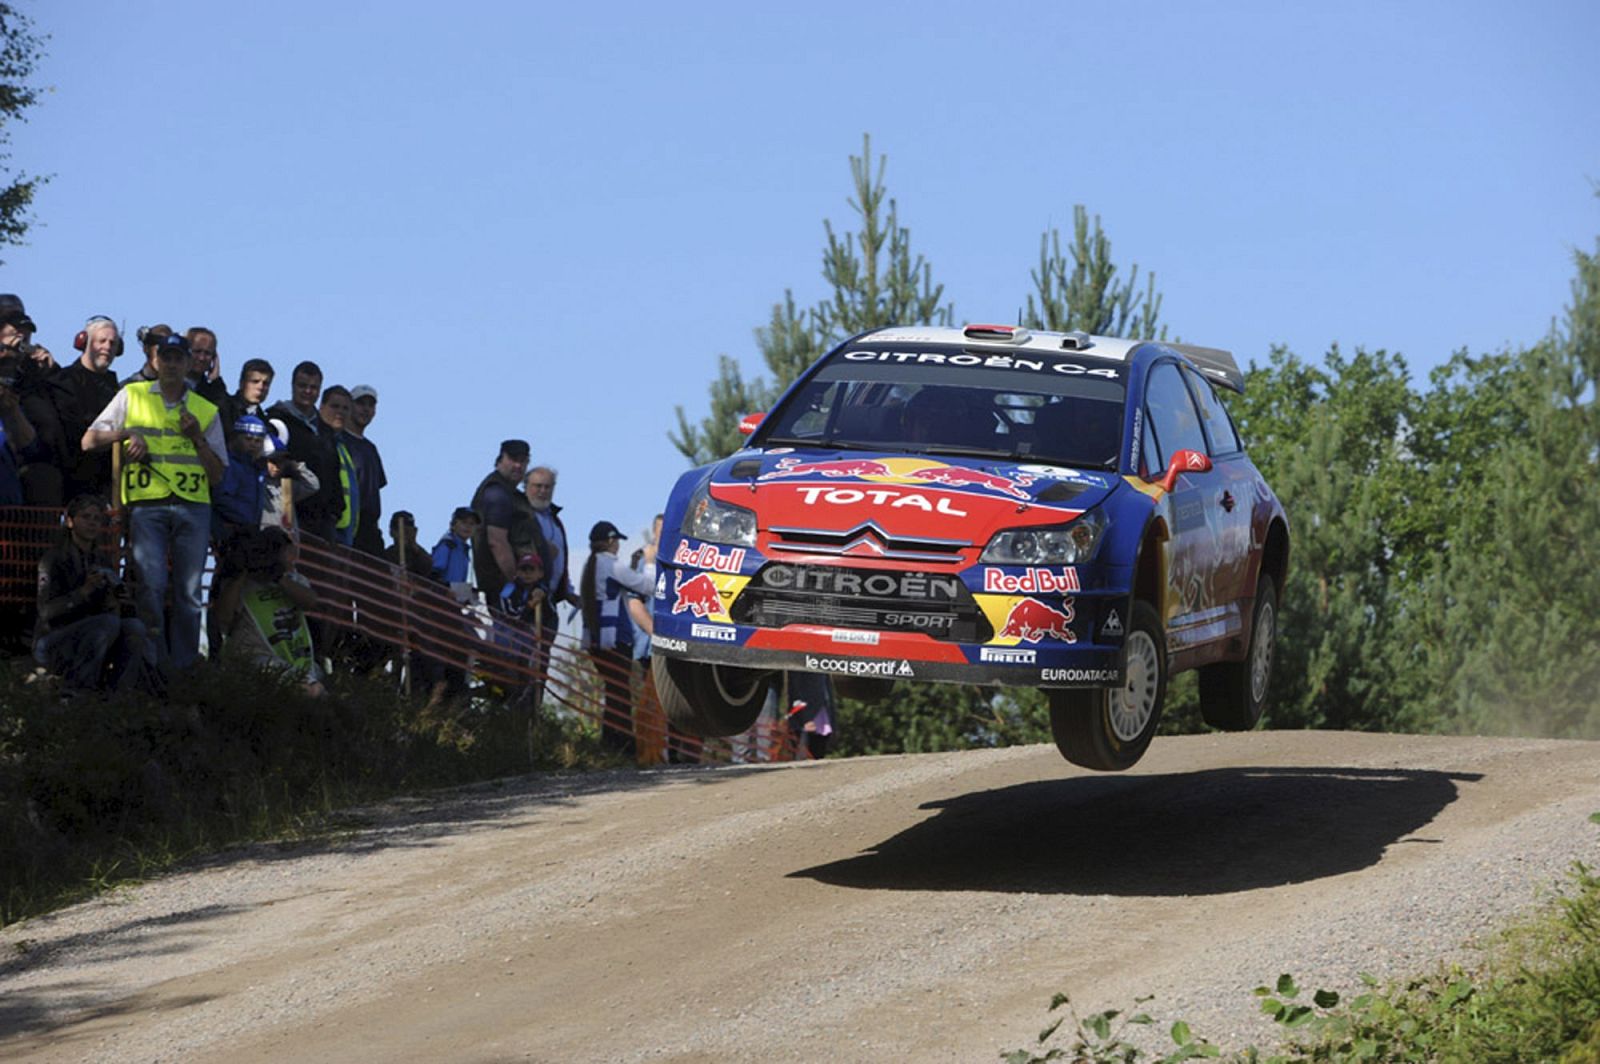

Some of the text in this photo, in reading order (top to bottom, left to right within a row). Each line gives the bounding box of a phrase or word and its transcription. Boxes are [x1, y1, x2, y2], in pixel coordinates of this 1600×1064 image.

[844, 351, 1119, 378] CITROËN C4
[796, 487, 967, 517] TOTAL
[699, 545, 746, 573] Bull
[762, 564, 958, 598] CITROËN
[984, 566, 1081, 593] Red Bull
[691, 623, 737, 641] PIRELLI
[884, 613, 959, 628] SPORT
[805, 654, 896, 676] le coq sportif
[980, 647, 1037, 664] PIRELLI
[1041, 668, 1120, 681] EURODATACAR
